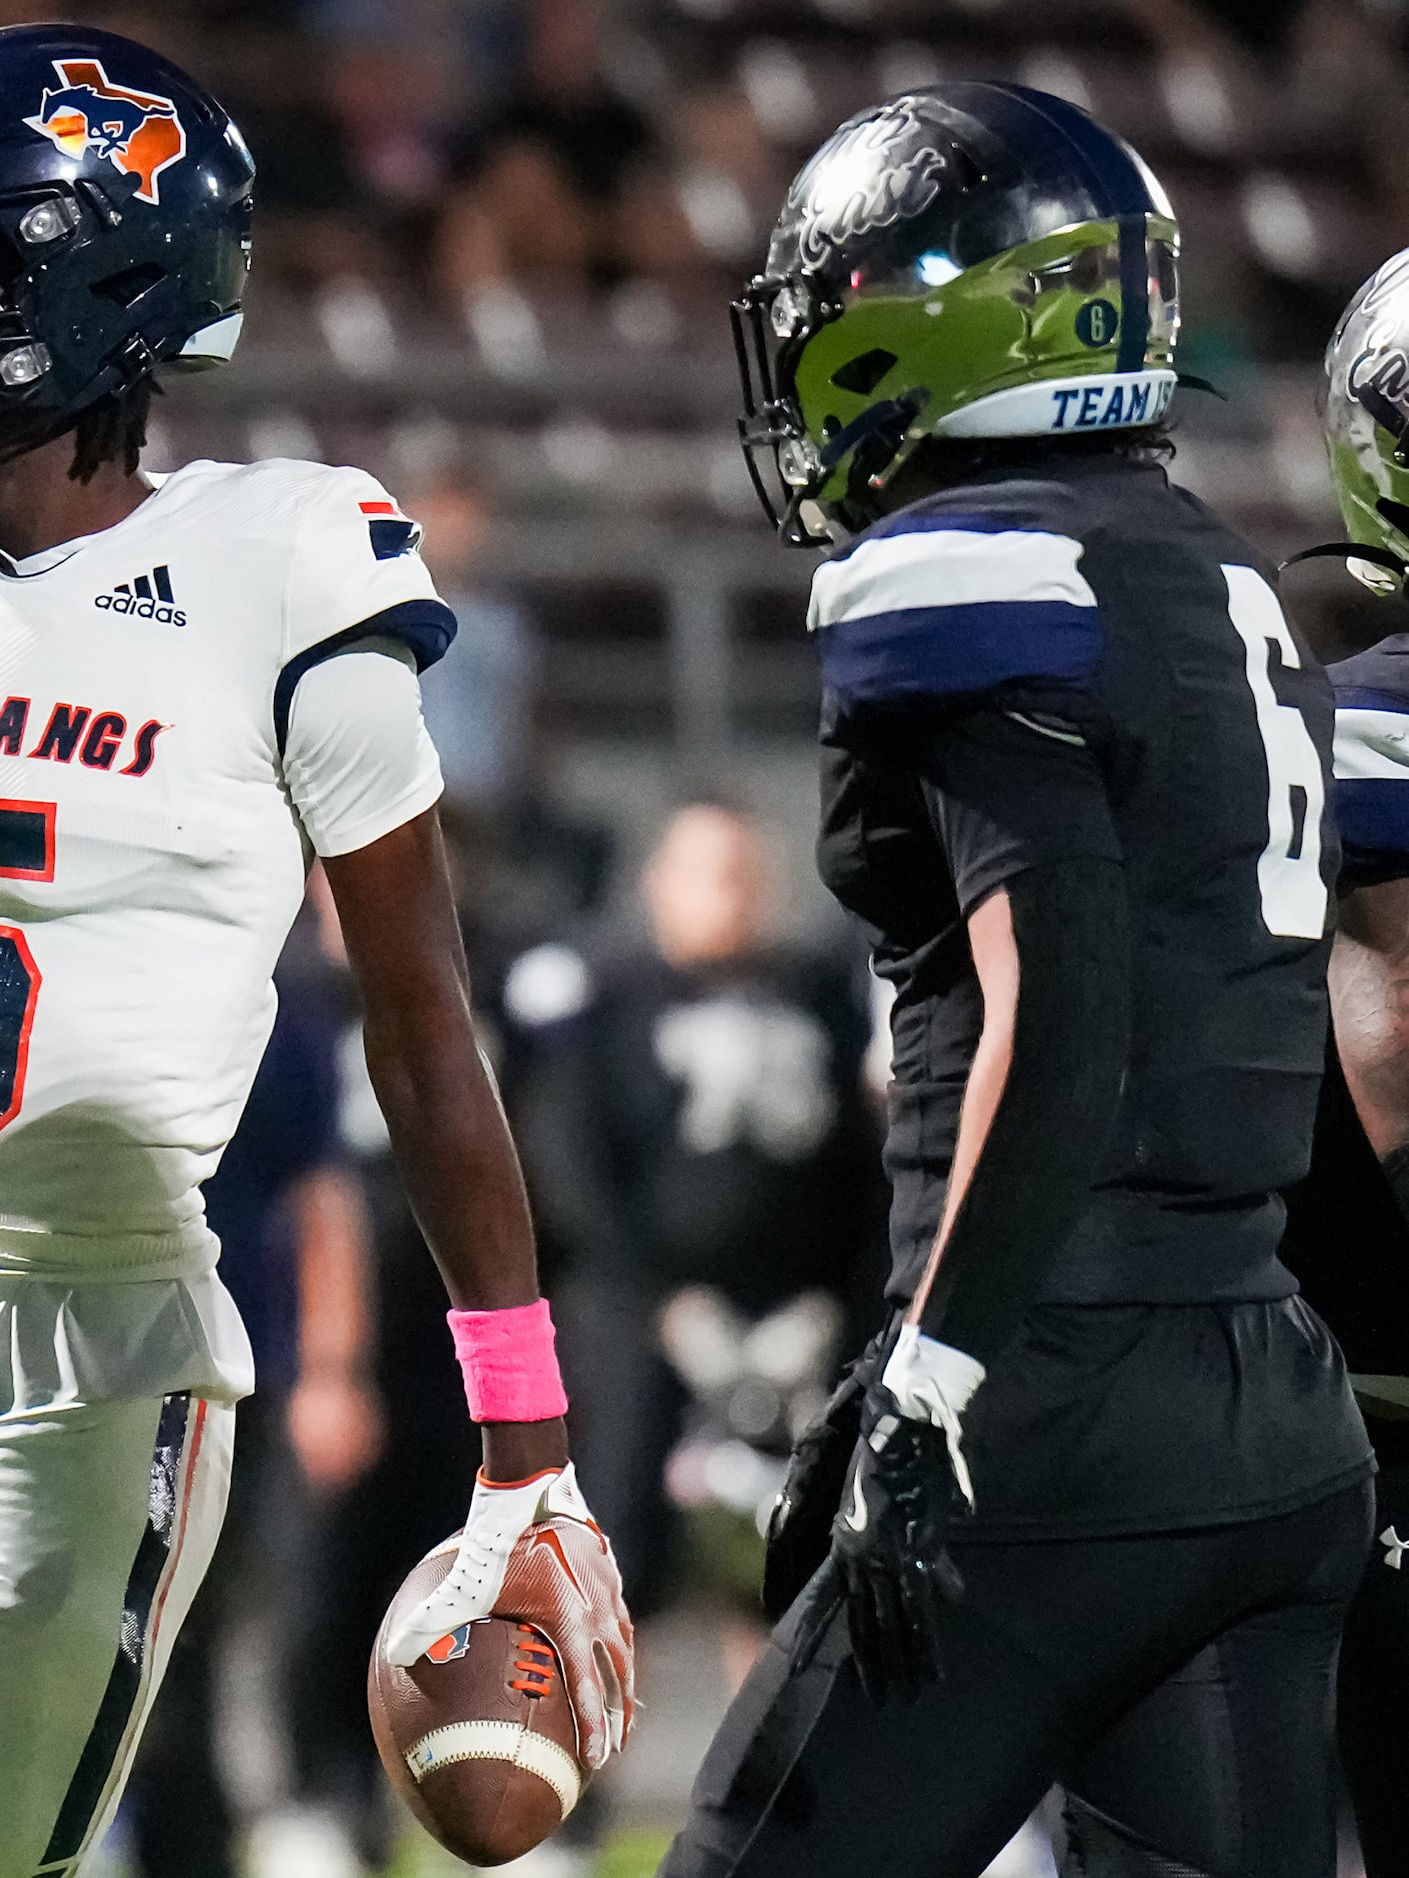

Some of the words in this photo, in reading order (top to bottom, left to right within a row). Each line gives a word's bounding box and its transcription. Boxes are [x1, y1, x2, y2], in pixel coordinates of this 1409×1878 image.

[1090, 305, 1106, 342] 6
[1051, 381, 1152, 431] TEAM
[94, 594, 187, 628] adidas
[1220, 563, 1328, 940] 6
